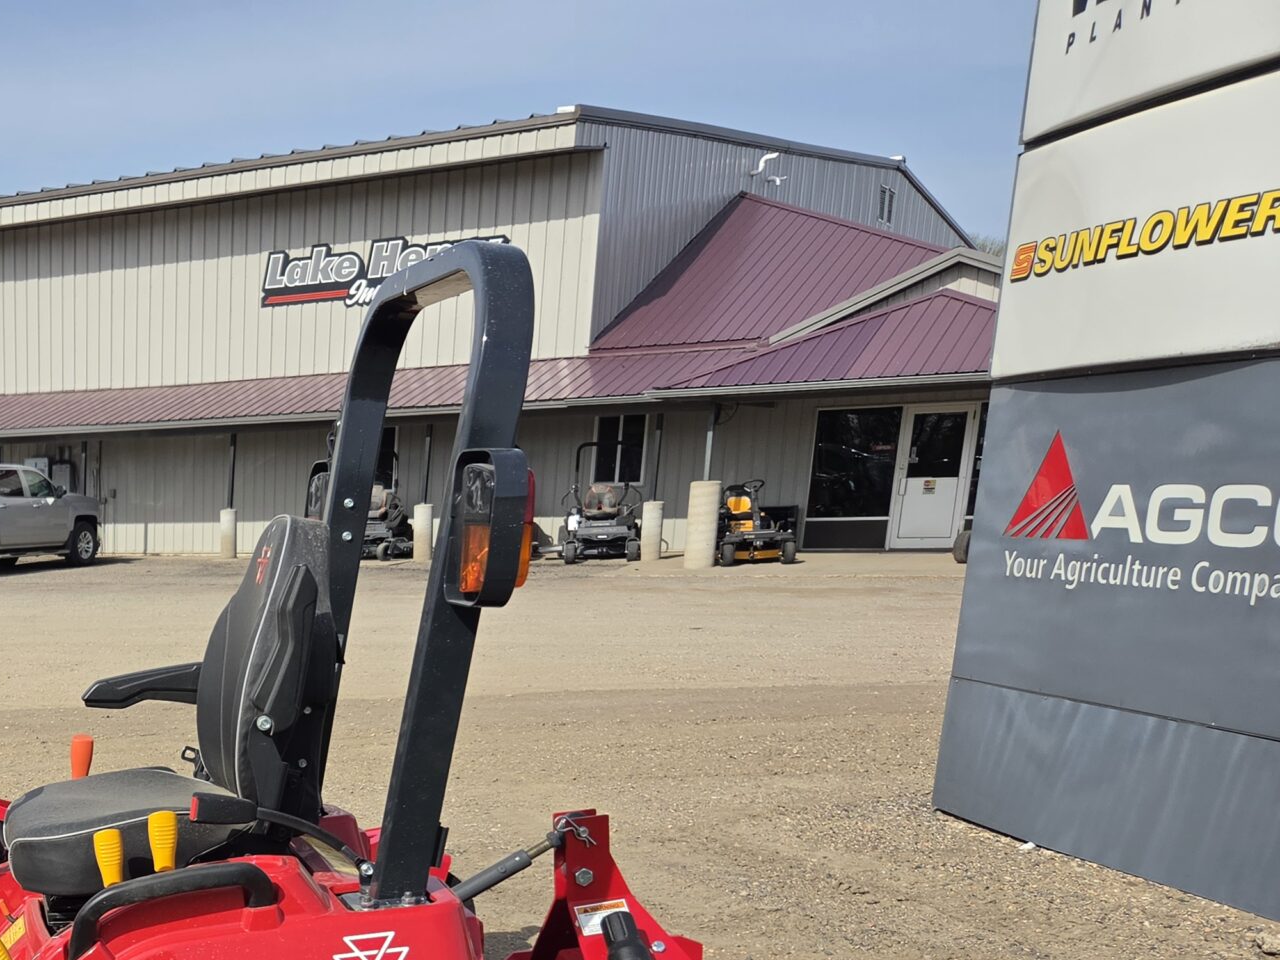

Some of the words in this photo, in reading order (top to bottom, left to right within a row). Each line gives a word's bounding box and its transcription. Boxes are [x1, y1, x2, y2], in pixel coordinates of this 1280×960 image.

[1065, 0, 1180, 55] PLAN
[1033, 188, 1280, 278] SUNFLOWER
[264, 246, 360, 290] Lake
[1090, 484, 1280, 548] AGC
[1004, 550, 1048, 579] Your
[1050, 553, 1182, 590] Agriculture
